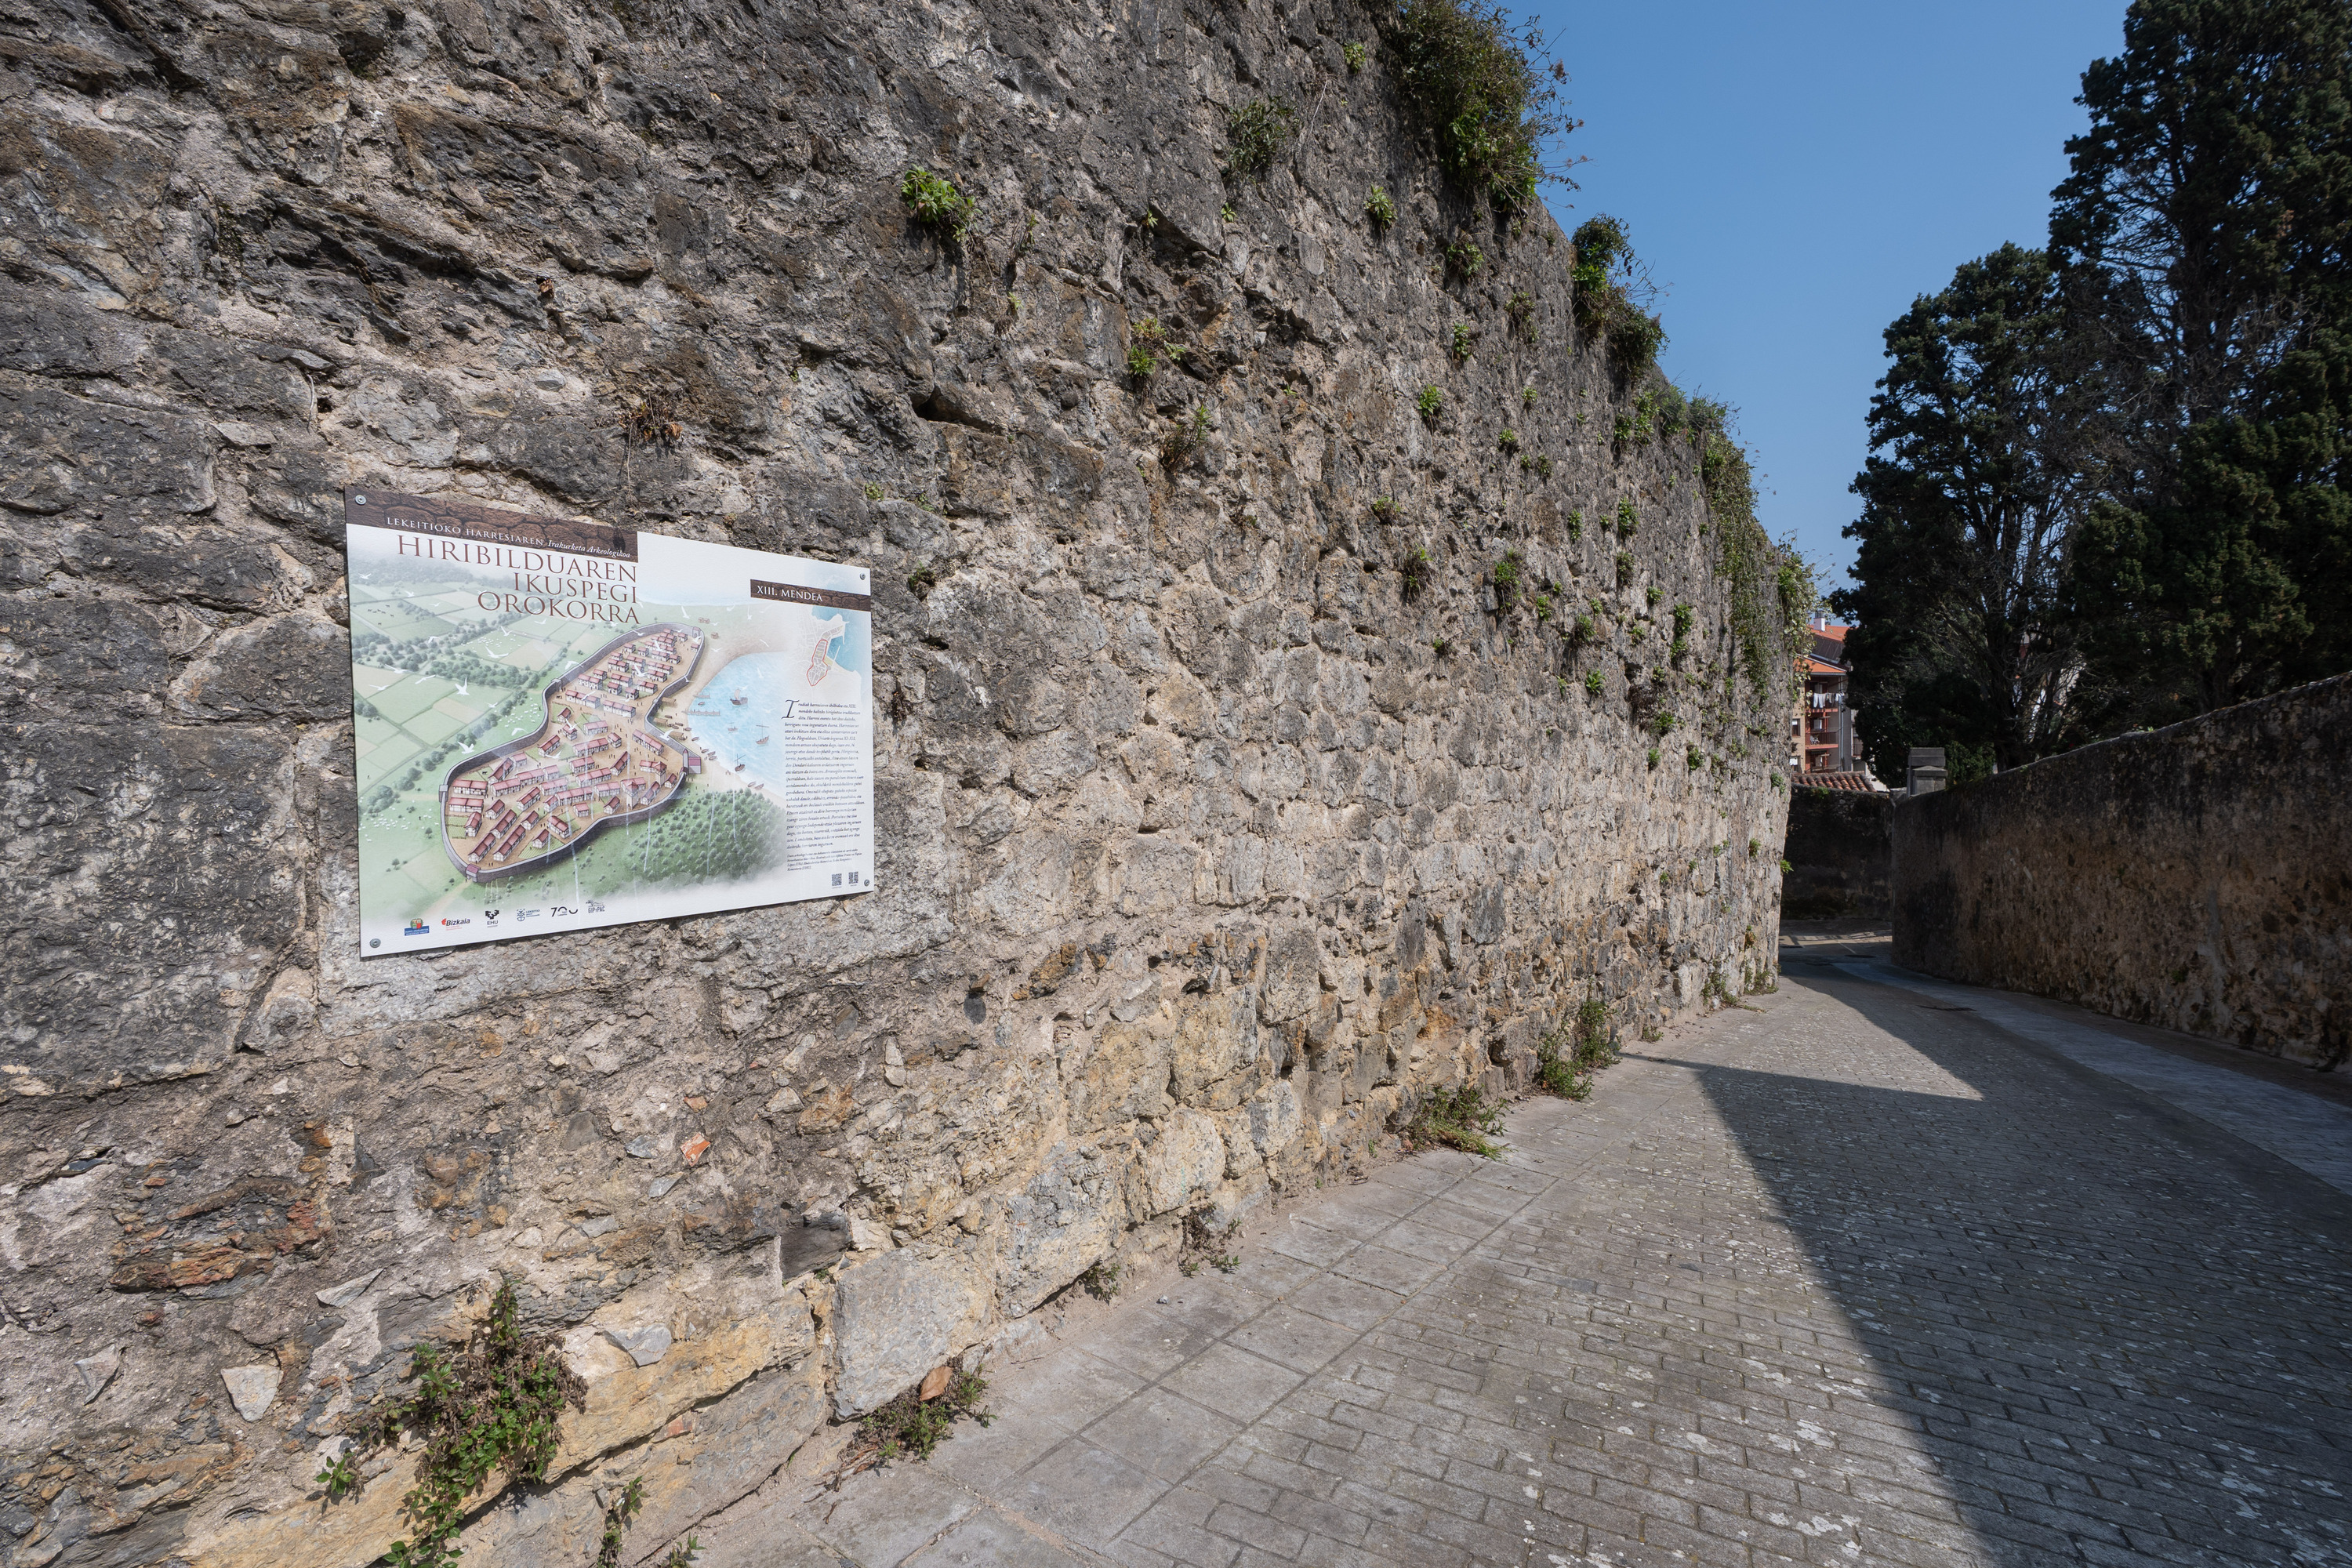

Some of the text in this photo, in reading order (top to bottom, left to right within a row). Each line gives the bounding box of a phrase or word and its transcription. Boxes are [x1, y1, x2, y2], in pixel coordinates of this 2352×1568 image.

[387, 517, 631, 559] LEKEITIOKO HARRESIAREN Irakurketa Arkeologikoa
[396, 534, 637, 583] HIRIBILDUAREN
[513, 572, 637, 604] IKUSPEGI
[757, 585, 823, 602] XIII. MENDEA
[477, 591, 641, 625] OROKORRA
[445, 918, 470, 927] Bizkaia
